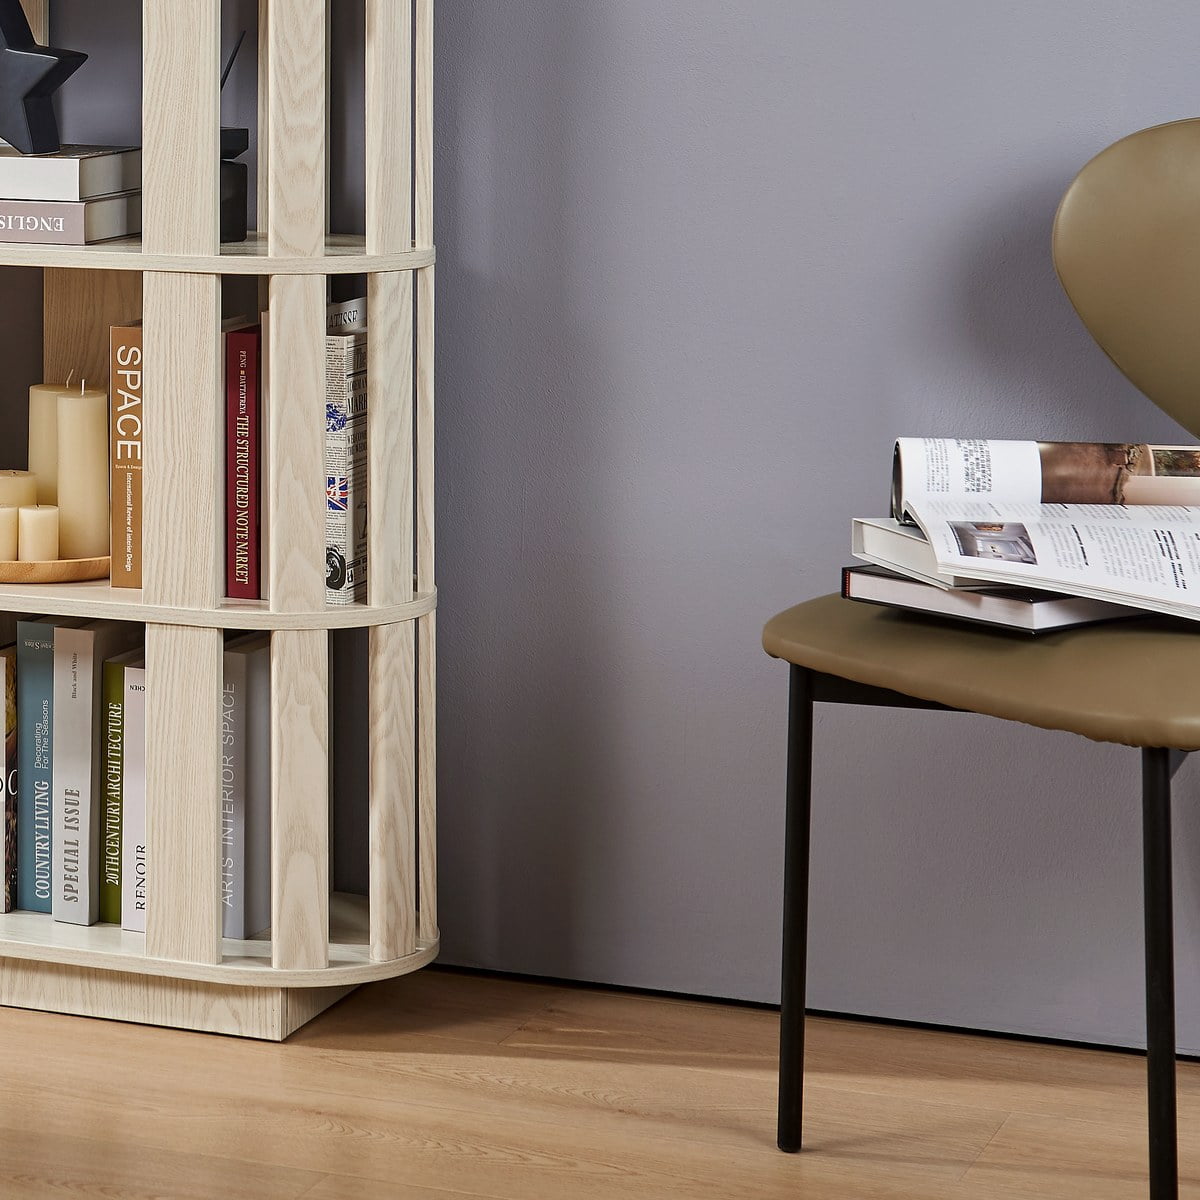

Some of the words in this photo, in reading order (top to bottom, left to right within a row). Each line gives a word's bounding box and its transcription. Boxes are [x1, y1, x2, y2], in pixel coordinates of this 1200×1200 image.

[327, 309, 358, 329] ATISSE
[239, 350, 247, 368] PENG
[116, 345, 142, 460] SPACE
[236, 415, 250, 437] THE
[236, 438, 249, 508] STRUCTURED
[236, 510, 249, 540] NOTE
[129, 684, 146, 692] CHEN
[41, 699, 49, 736] Seasons
[222, 682, 236, 746] SPACE
[33, 722, 43, 769] Decorating
[41, 737, 49, 753] The
[41, 754, 49, 769] For
[34, 781, 49, 833] LIVING
[65, 788, 80, 833] ISSUE
[221, 755, 235, 846] INTERIOR
[35, 833, 50, 898] COUNTRY
[63, 839, 79, 903] SPECIAL
[135, 845, 146, 910] RENOIR
[221, 857, 234, 908] ARTS
